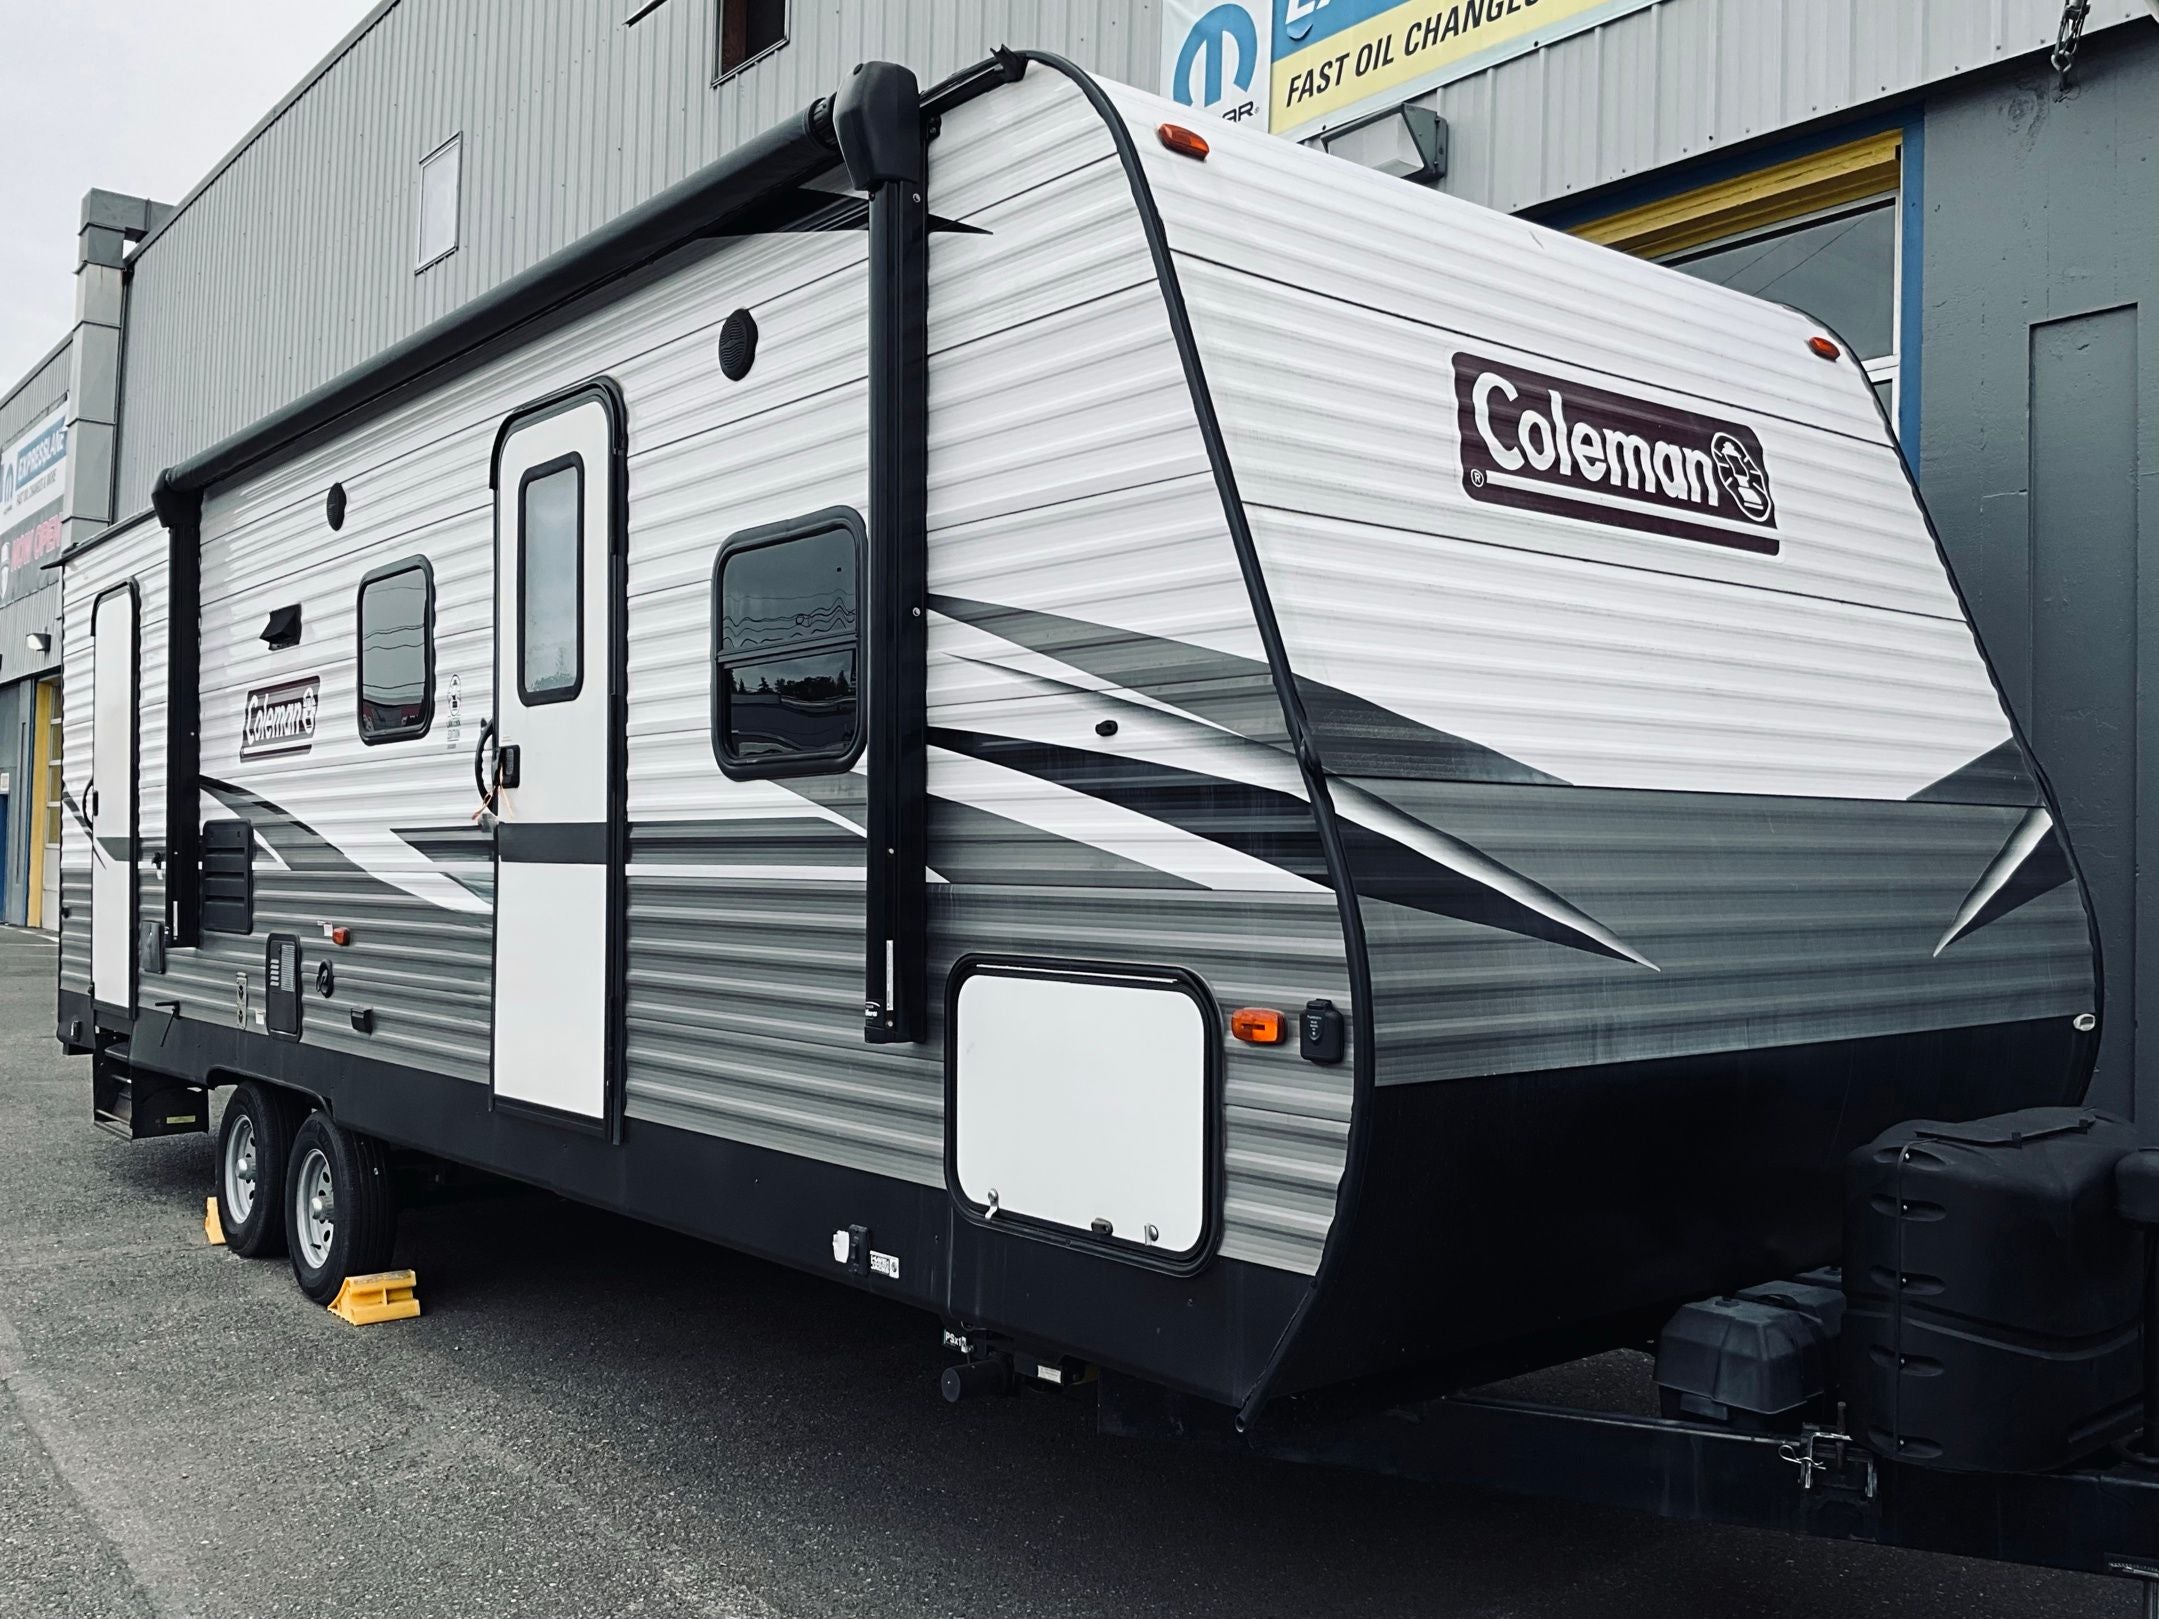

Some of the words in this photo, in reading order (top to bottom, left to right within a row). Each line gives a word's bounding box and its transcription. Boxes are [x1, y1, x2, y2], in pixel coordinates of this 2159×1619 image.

[1286, 52, 1350, 108] FAST
[1355, 33, 1395, 77] OIL
[1404, 0, 1539, 56] CHANG
[1472, 371, 1719, 506] Coleman
[246, 693, 302, 745] Coleman
